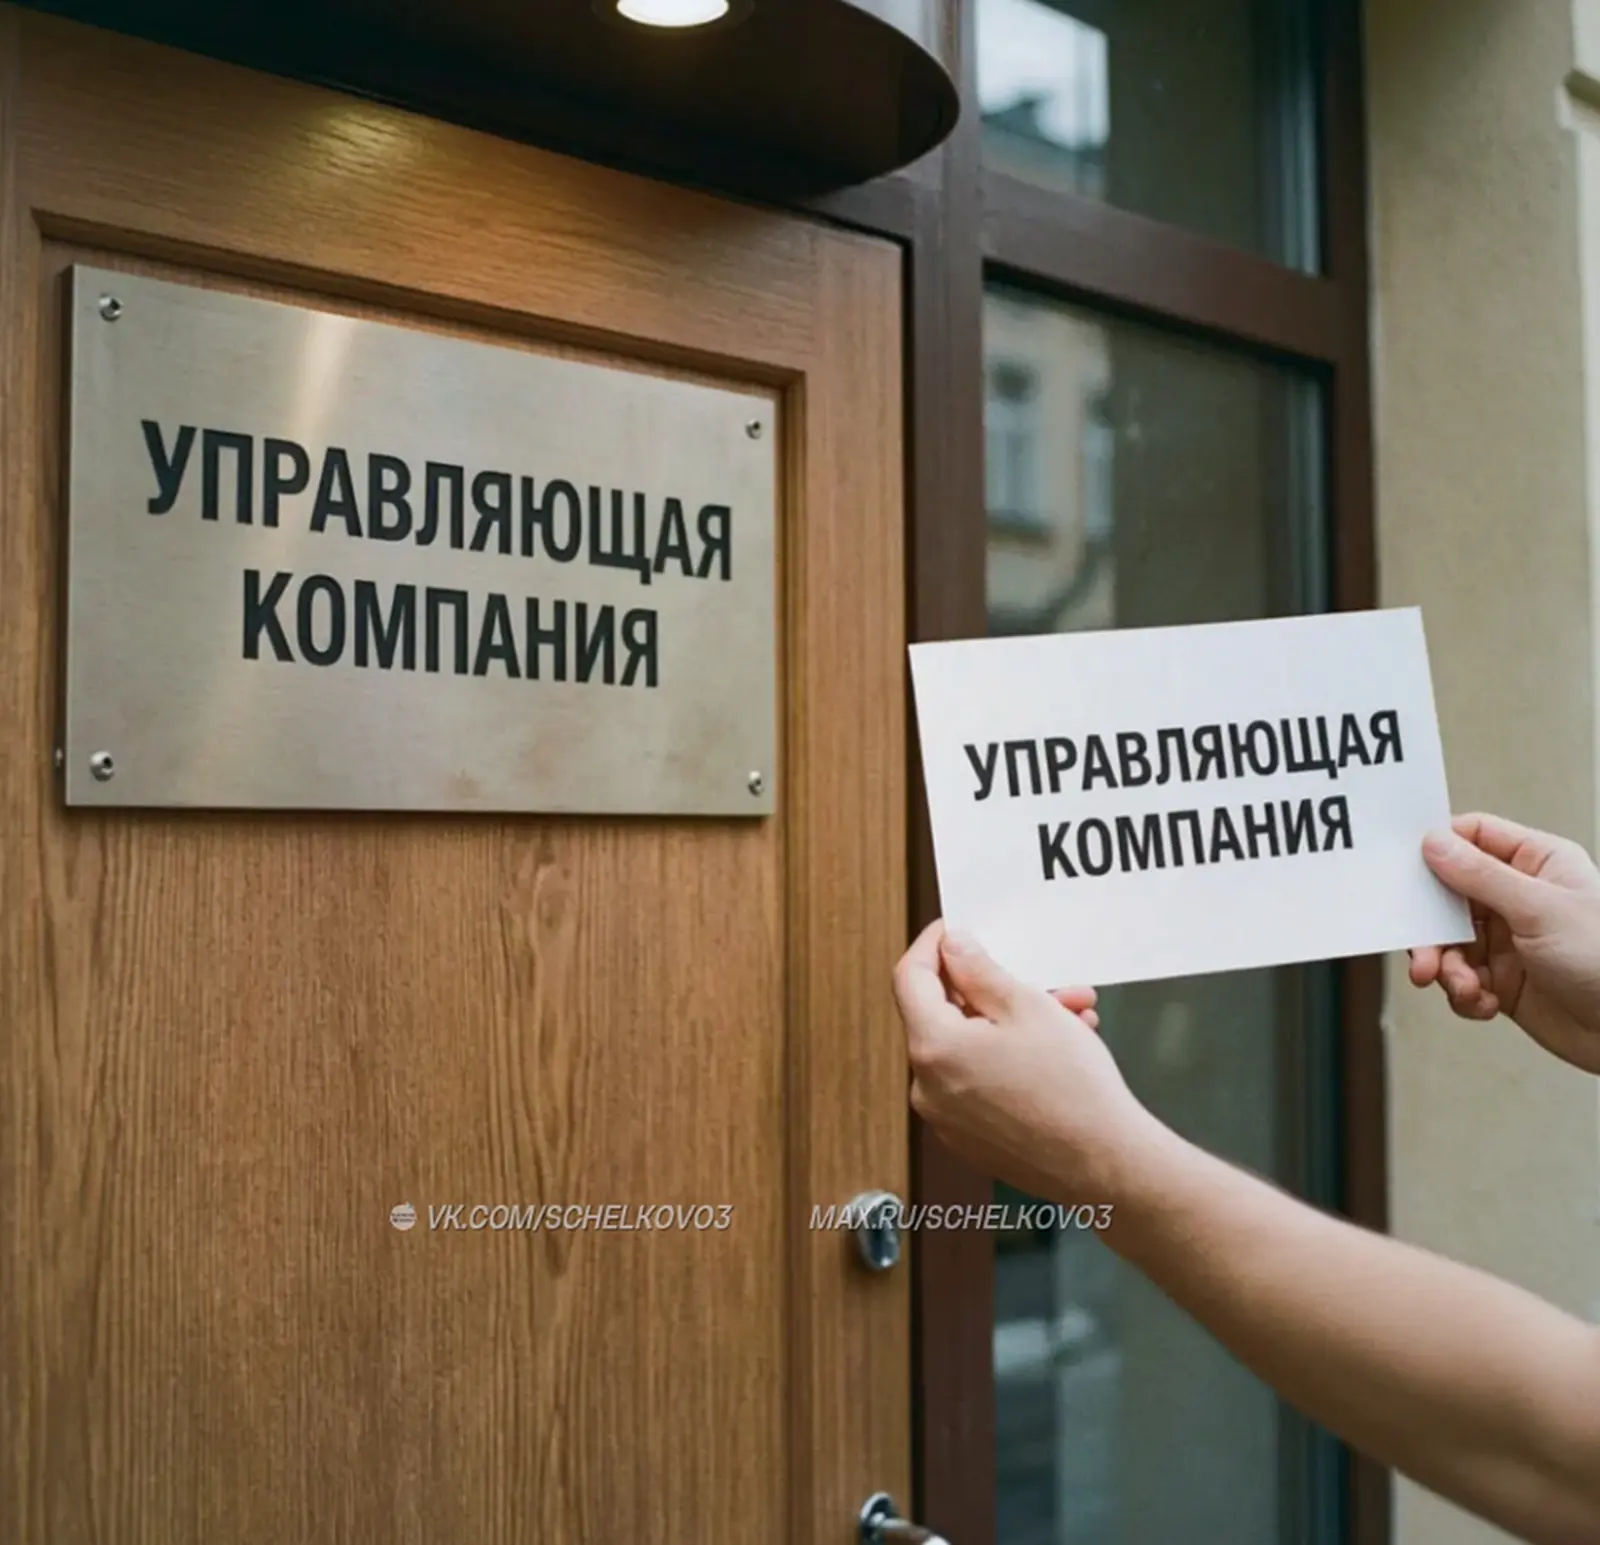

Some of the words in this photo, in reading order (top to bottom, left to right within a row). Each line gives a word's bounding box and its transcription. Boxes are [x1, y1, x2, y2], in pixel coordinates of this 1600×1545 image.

[140, 418, 732, 585] УПРАВЛЯЮЩАЯ
[242, 568, 659, 688] КОМПАНИЯ
[963, 709, 1404, 801] УПРАВЛЯЮЩАЯ
[1037, 794, 1354, 881] КОМПАНИЯ
